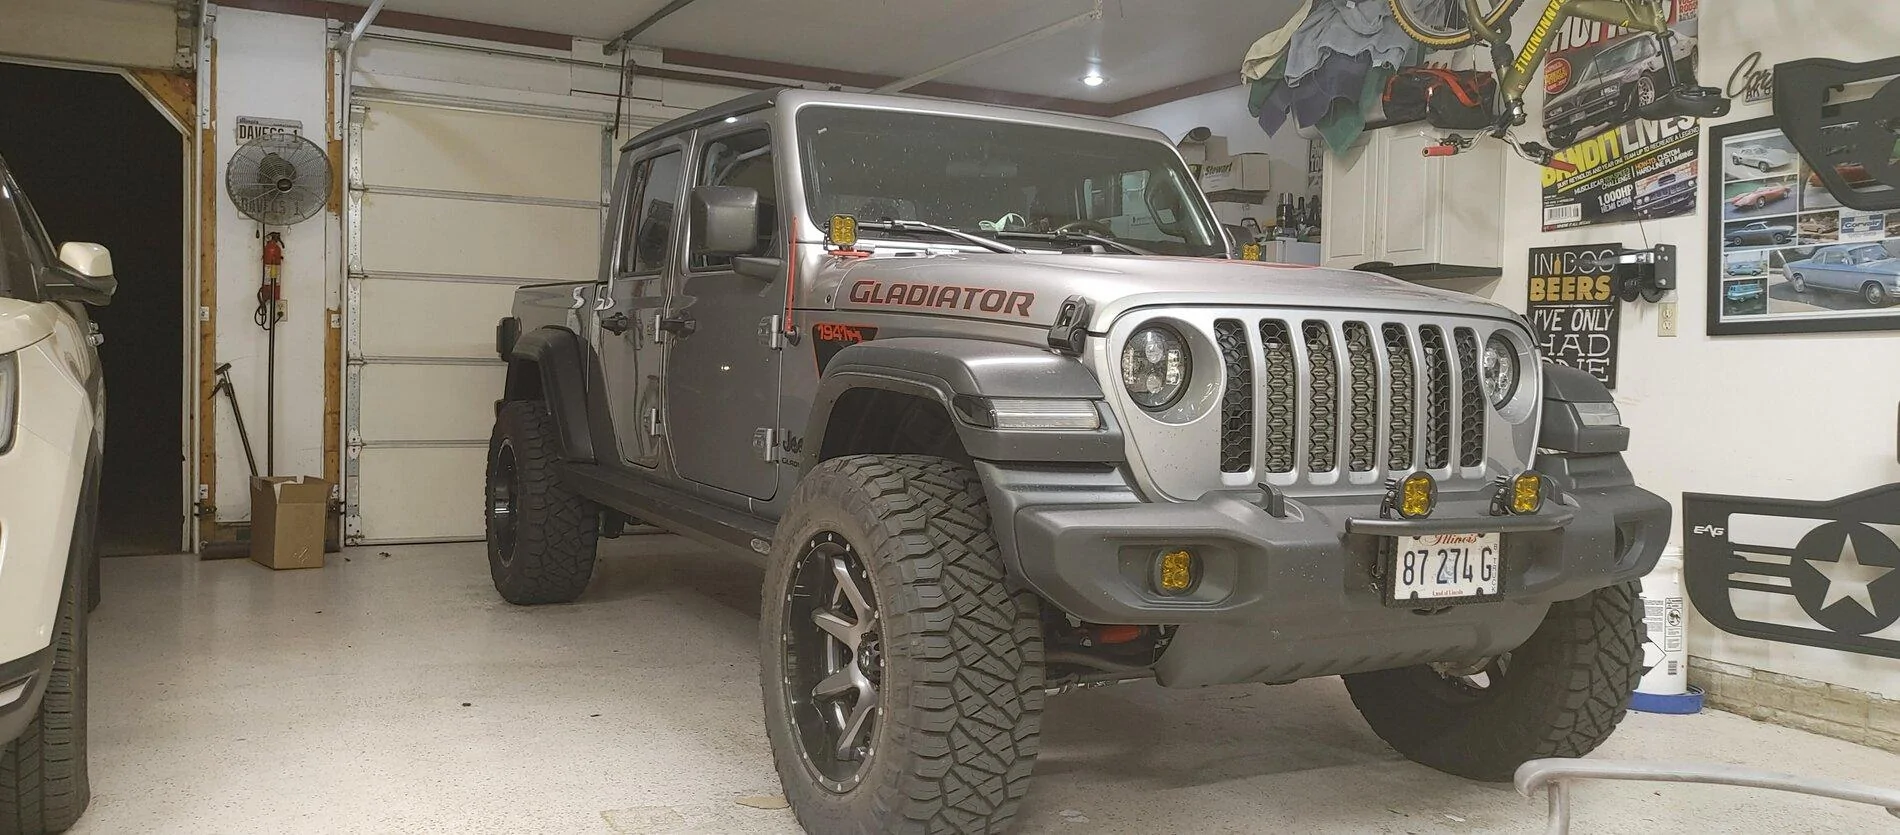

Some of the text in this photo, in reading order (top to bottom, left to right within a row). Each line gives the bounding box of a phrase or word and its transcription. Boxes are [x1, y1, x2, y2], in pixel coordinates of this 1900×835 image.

[1514, 0, 1566, 74] ANNONDALE
[1592, 167, 1603, 175] AND
[1624, 153, 1637, 161] TEAM
[1656, 147, 1681, 160] CUSTOM
[1664, 149, 1694, 166] PLUMBING
[1534, 253, 1553, 276] IN
[849, 279, 1036, 318] GLADIATOR
[1533, 309, 1615, 331] I'VE ONLY
[817, 324, 849, 341] 1941
[1428, 533, 1478, 546] Illinois
[1402, 548, 1492, 586] 87 274 G
